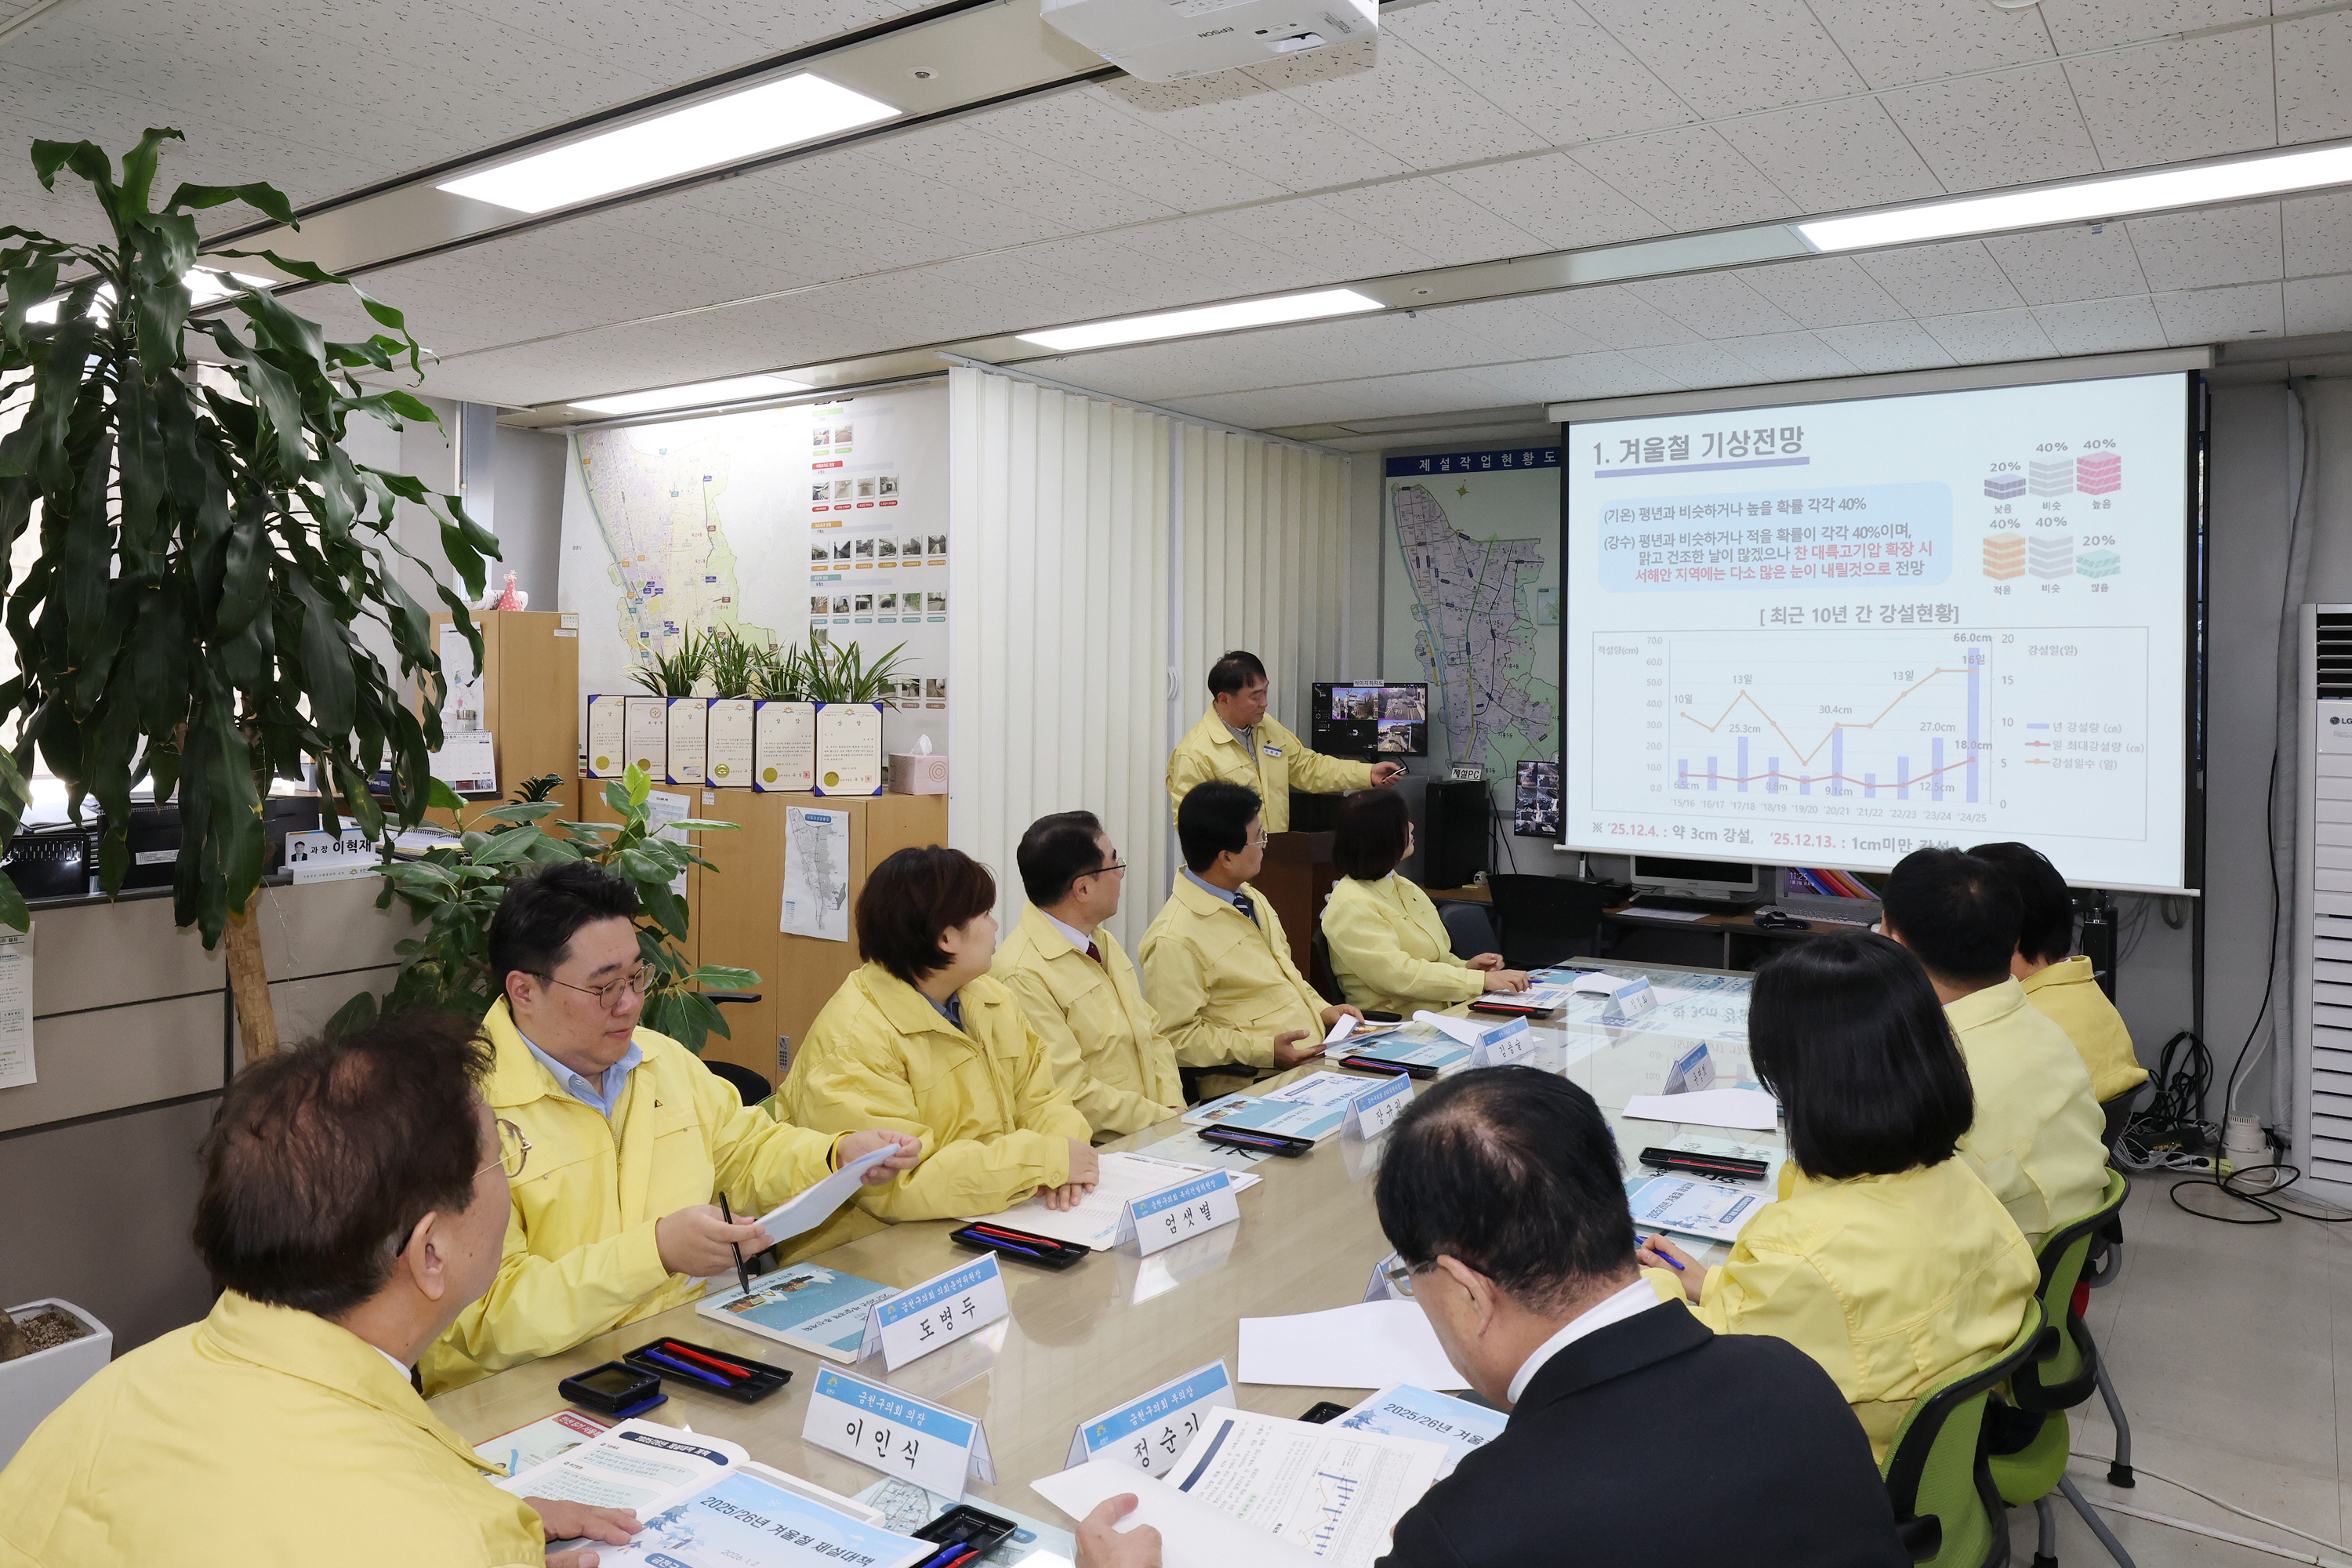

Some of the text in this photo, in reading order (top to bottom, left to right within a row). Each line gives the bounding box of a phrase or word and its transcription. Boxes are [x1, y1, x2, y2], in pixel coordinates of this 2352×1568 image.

[1197, 26, 1235, 39] EPSON
[1593, 426, 1805, 465] 1. 겨울철 기상전망
[2035, 441, 2068, 452] 40%
[2083, 438, 2117, 449] 40%
[1990, 461, 2021, 472] 20%
[2042, 501, 2062, 511] 비슷
[2092, 499, 2111, 510] 높음
[1604, 497, 1867, 524] (기온) 평년과 비슷하거나 높을 확률 각각 40%
[1989, 518, 2021, 529] 40%
[2035, 516, 2067, 528] 40%
[1604, 522, 1912, 550] (강수) 평년과 비슷하거나 적을 확률이 각각 40%이며,
[2082, 535, 2116, 546] 20%
[1639, 540, 1933, 566] 맑고 건조한 날이 많겠으나 찬 대륙고기압 확장 시
[1635, 559, 1926, 583] 서해안 지역에는 다소 많은 눈이 내릴것으로 전망
[1993, 585, 2012, 596] 적음
[2042, 583, 2061, 593] 비슷
[2091, 583, 2110, 593] 많음
[1770, 603, 1960, 625] 최근 10년 간 강설현황]
[1646, 636, 1663, 645] 70.0
[1953, 633, 1992, 643] 66.0cm
[2002, 633, 2014, 644] 20
[1598, 645, 1639, 656] 적설량(cm)
[2027, 644, 2078, 657] 강설일(일)
[1646, 657, 1663, 666] 60.0
[1962, 654, 1985, 666] 16일
[1732, 673, 1752, 685] 13일
[1892, 670, 1915, 681] 13일
[2002, 675, 2014, 685] 15
[1646, 678, 1663, 687] 50.0
[1646, 699, 1663, 708] 40.0
[1674, 694, 1693, 705] 10일
[1819, 705, 1853, 715] 30.4cm
[1646, 720, 1662, 729] 30.0
[1920, 722, 1956, 732] 27.0cm
[2002, 717, 2013, 728] 10
[2053, 722, 2063, 732] 년
[2067, 721, 2100, 734] 강설량
[1729, 724, 1762, 734] 25.3cm
[1646, 742, 1662, 750] 20.0
[1955, 739, 1993, 750] 18.0cm
[2053, 739, 2063, 752] 일
[2067, 740, 2122, 753] 최대강설량
[1646, 763, 1662, 771] 10.0
[2001, 759, 2007, 768] 5
[2052, 758, 2118, 771] 강설일수 (일)
[1453, 768, 1480, 780] 제설PC
[1650, 784, 1662, 793] 0.0
[1674, 780, 1700, 790] 6.5cm
[1919, 782, 1955, 793] 12.5cm
[1825, 786, 1853, 797] 9.1cm
[2000, 800, 2007, 809] 0
[1672, 825, 1686, 840] 약
[1690, 827, 1718, 841] 3cm
[1723, 828, 1755, 845] 강설,
[1851, 837, 1913, 854] 1cm미만
[310, 839, 372, 855] 과장 이혁재
[1789, 873, 1809, 882] 11:25
[1499, 1038, 1522, 1058] 김용술
[1151, 1192, 1178, 1210] 금천구의회
[1165, 1201, 1212, 1235] 엄샛별
[901, 1269, 982, 1313] 금천구의회 의회운영위원장
[919, 1298, 978, 1342] 도병두
[858, 1392, 926, 1427] 금천구의회 의장
[1129, 1386, 1195, 1427] 금천구의회 부의장
[1383, 1403, 1494, 1446] 2025/26년 겨울
[846, 1417, 920, 1470] 이인식
[1134, 1412, 1201, 1468] 정순기
[700, 1496, 877, 1567] 2025/26년 겨울철 제설대책
